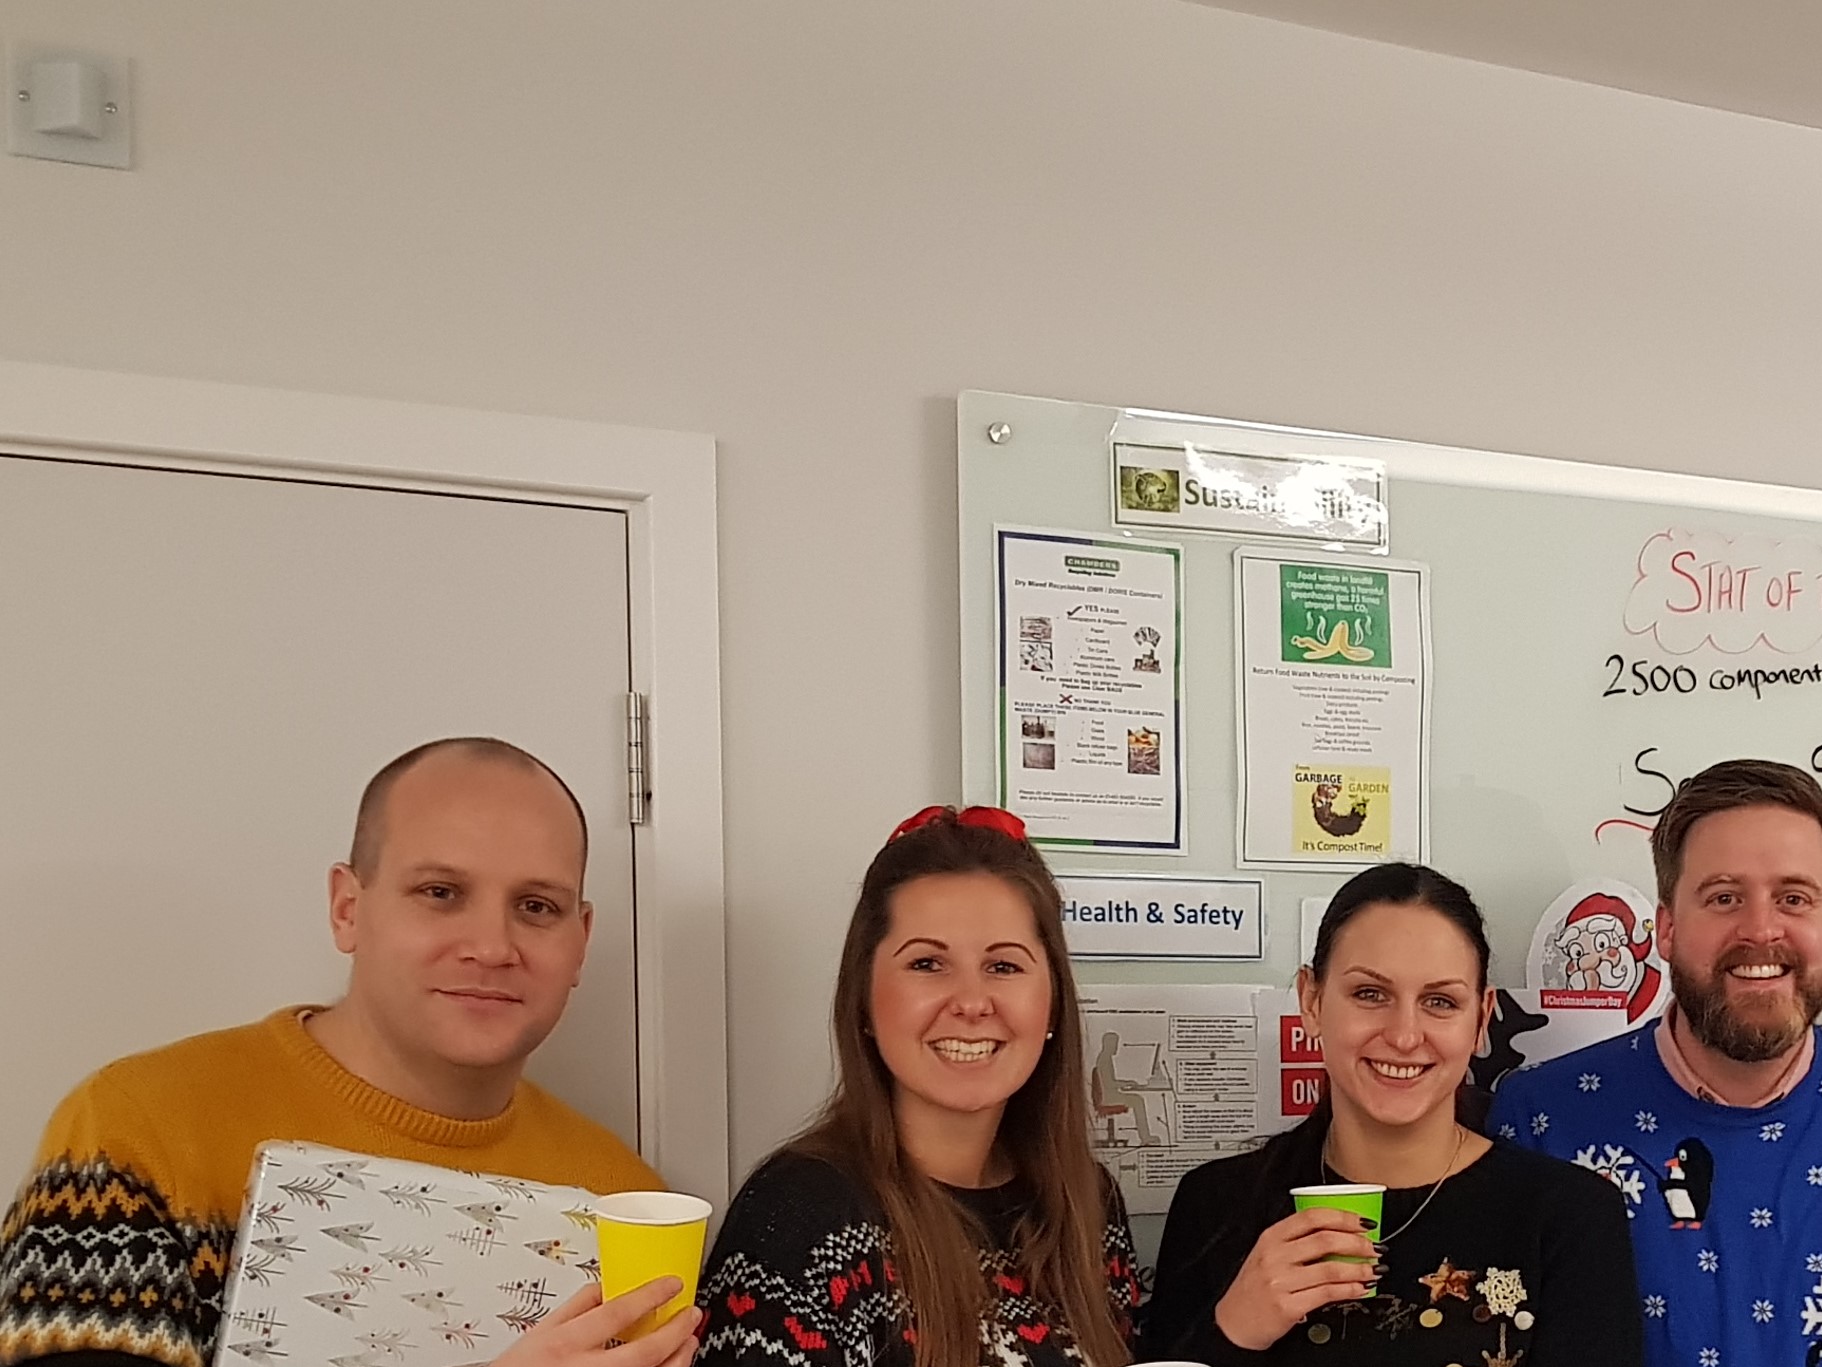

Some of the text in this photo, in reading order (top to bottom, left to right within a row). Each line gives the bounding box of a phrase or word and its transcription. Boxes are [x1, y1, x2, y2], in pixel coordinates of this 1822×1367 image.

[1184, 478, 1379, 525] Sustainility
[1666, 551, 1761, 614] STAT
[1766, 571, 1803, 613] OF
[1084, 605, 1099, 613] YES
[1252, 666, 1274, 675] Return
[1275, 667, 1291, 677] Food
[1350, 672, 1360, 680] the
[1602, 653, 1698, 698] 2500
[1294, 772, 1343, 784] GARBAGE
[1348, 782, 1390, 794] GARDEN
[1302, 840, 1384, 853] It's Compost Time!
[1061, 900, 1244, 931] Health & Safety
[1292, 1078, 1320, 1105] ON
